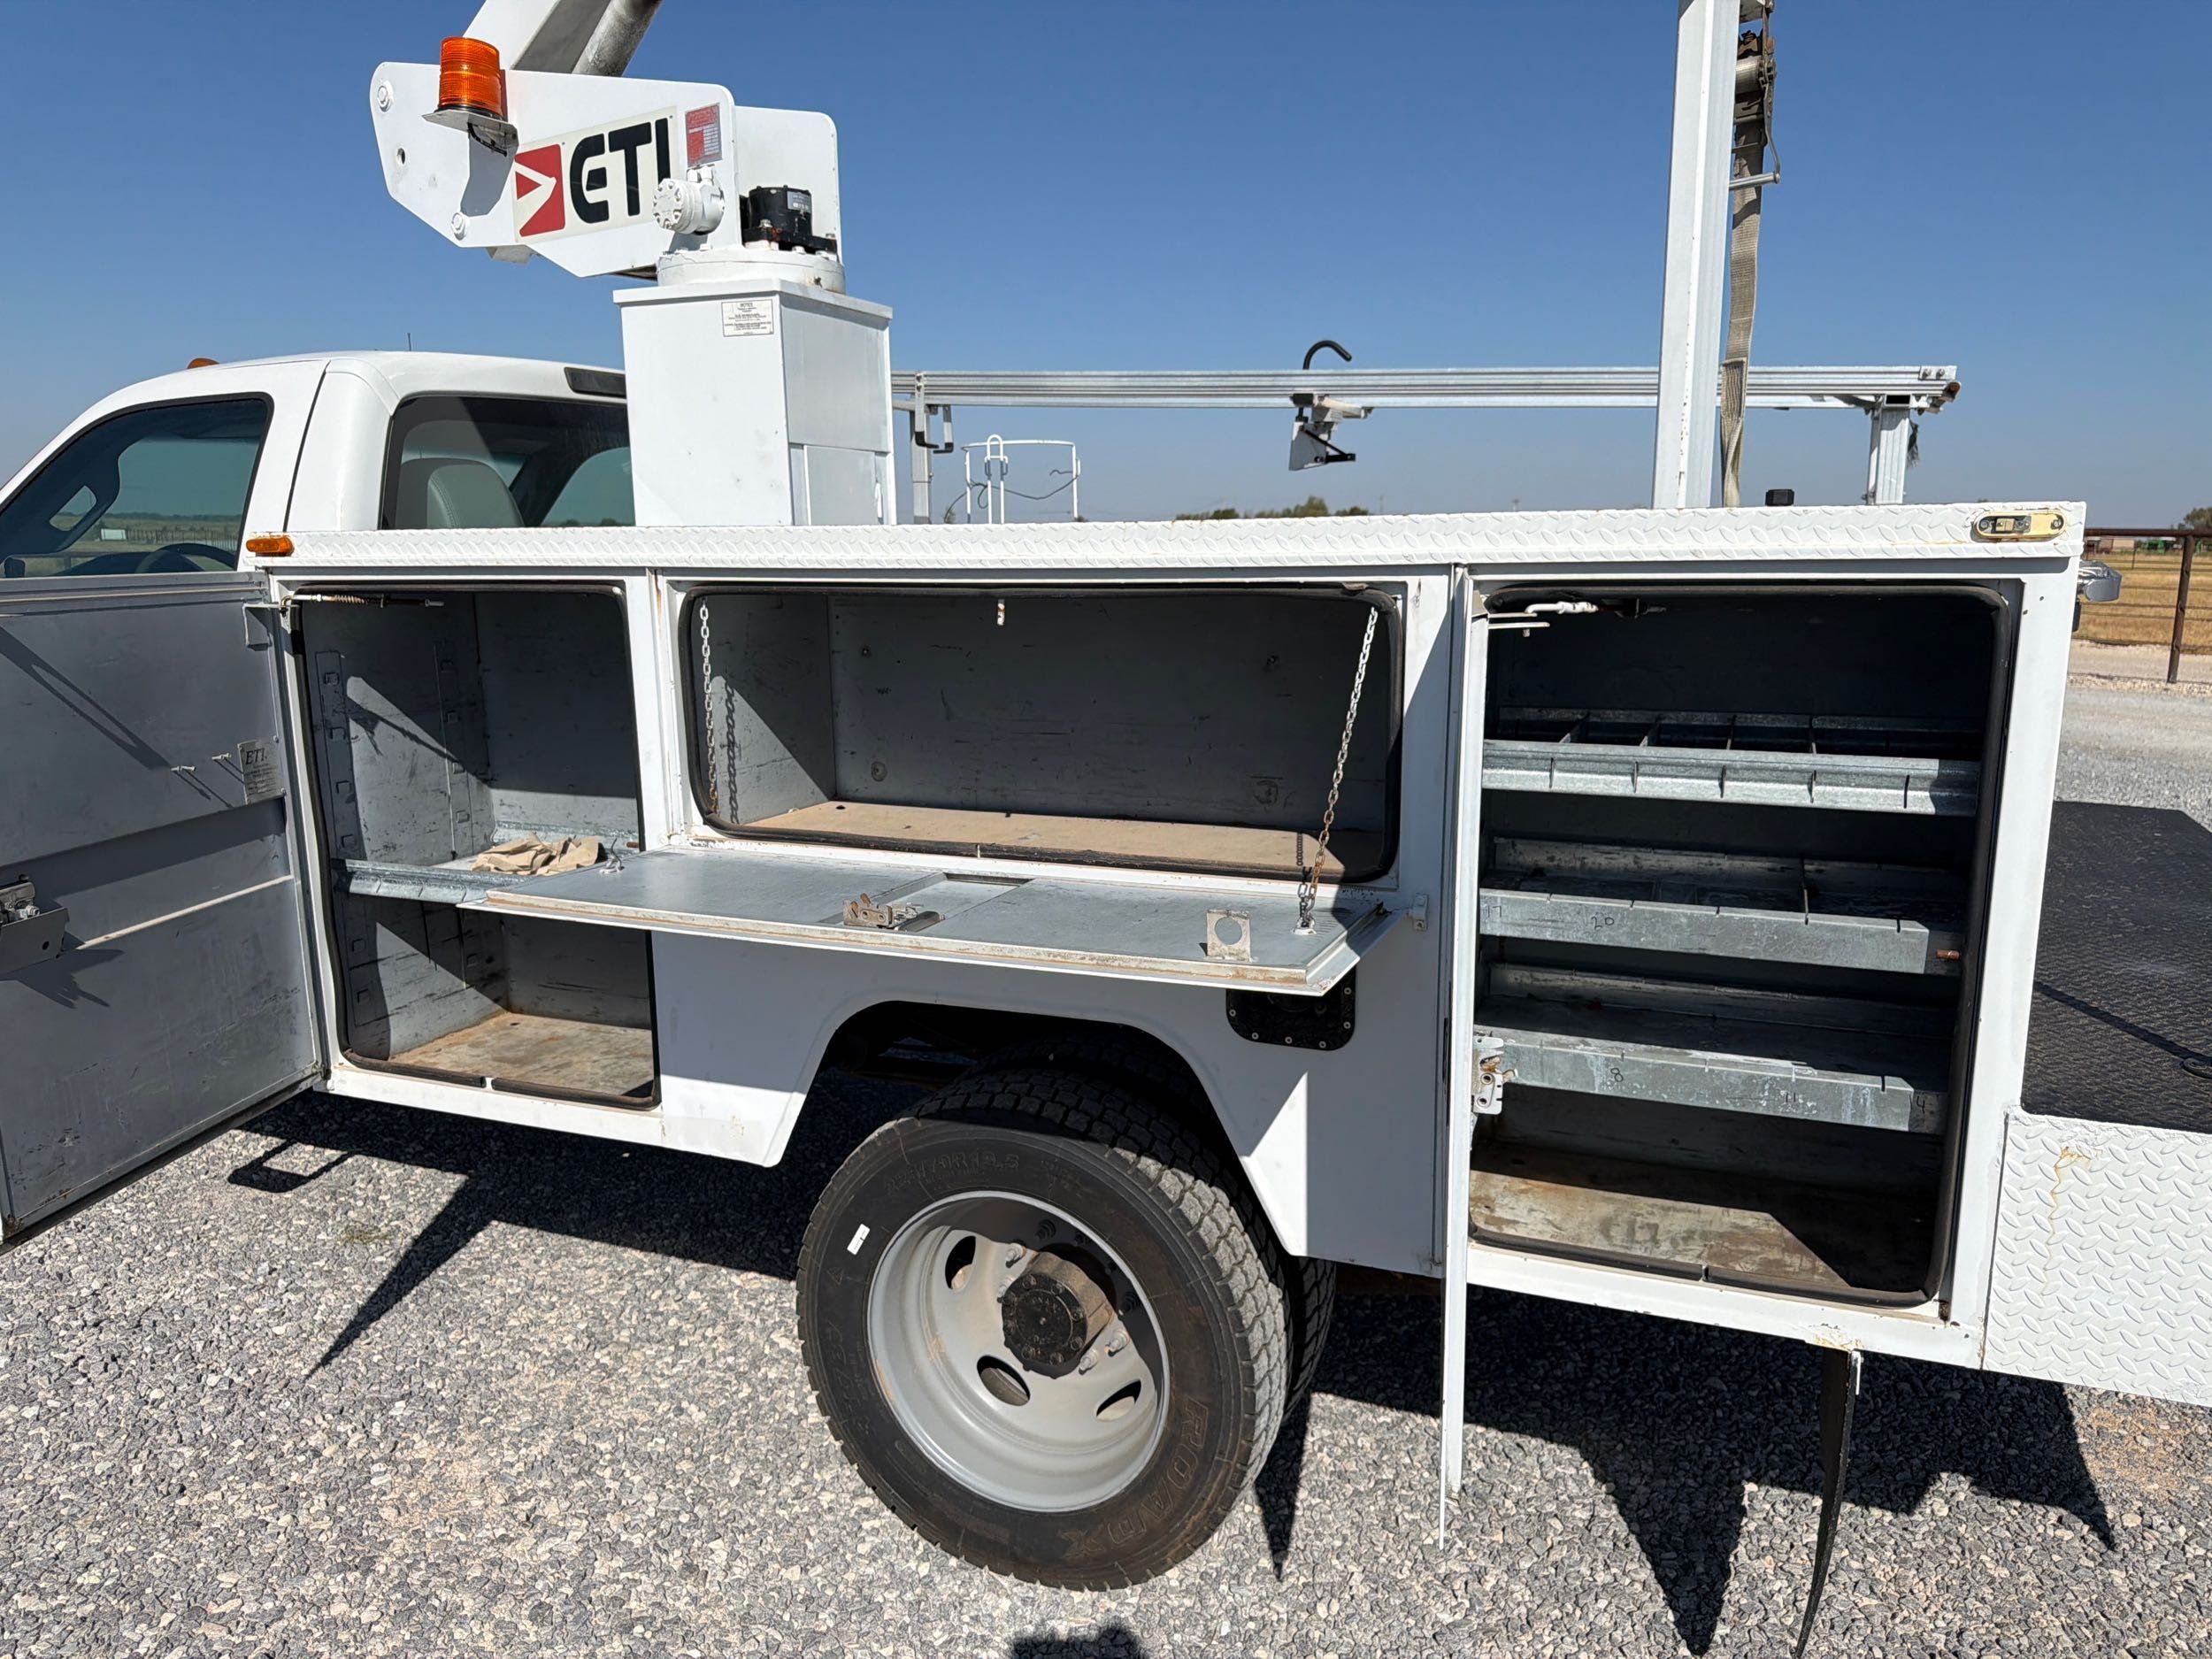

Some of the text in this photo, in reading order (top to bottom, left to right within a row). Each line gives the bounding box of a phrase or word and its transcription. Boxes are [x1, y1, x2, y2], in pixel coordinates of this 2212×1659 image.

[569, 117, 672, 224] ETI
[1591, 916, 1615, 930] 20
[1610, 1067, 1624, 1082] 8
[1058, 1394, 1209, 1563] ROADX
